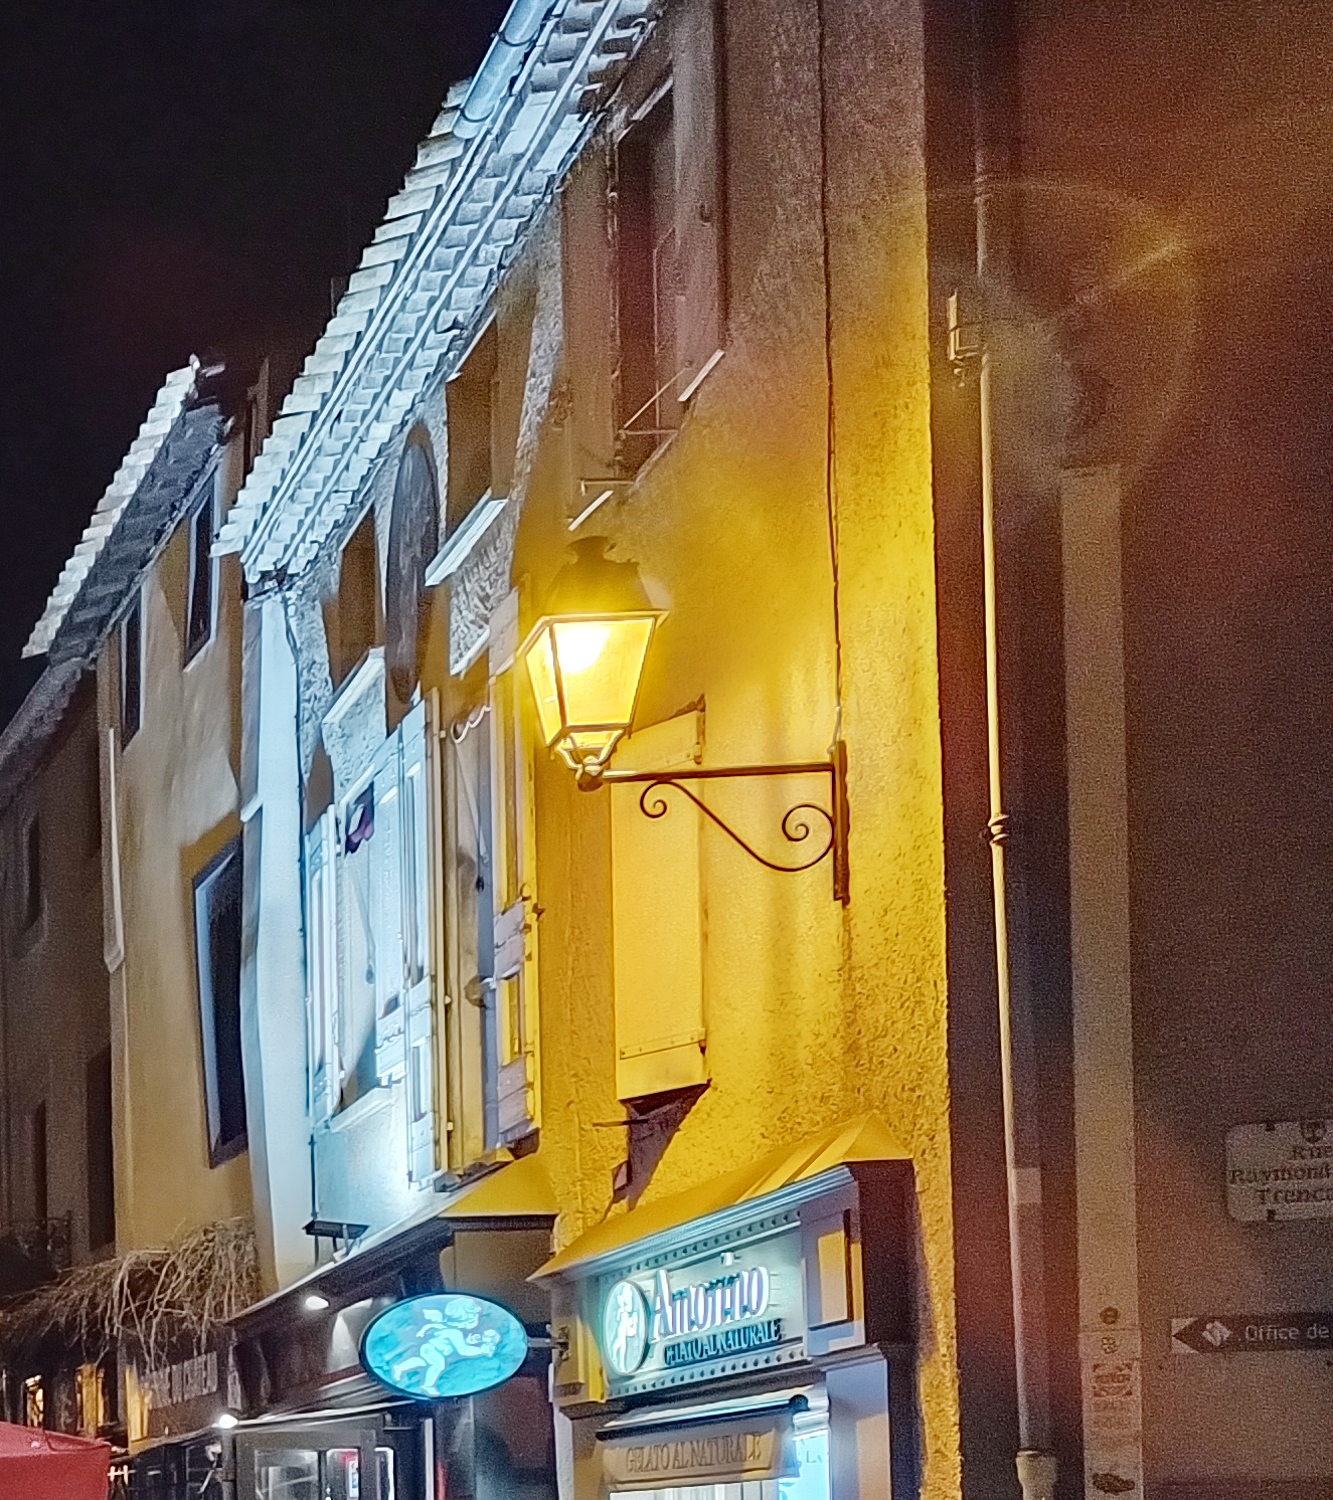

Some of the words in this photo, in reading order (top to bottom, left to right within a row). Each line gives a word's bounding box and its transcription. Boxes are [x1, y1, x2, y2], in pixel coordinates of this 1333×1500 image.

[649, 1253, 770, 1345] Amorino
[1245, 1324, 1299, 1341] Office
[1306, 1322, 1330, 1340] de
[626, 1441, 670, 1473] GELATO
[671, 1440, 688, 1469] AL
